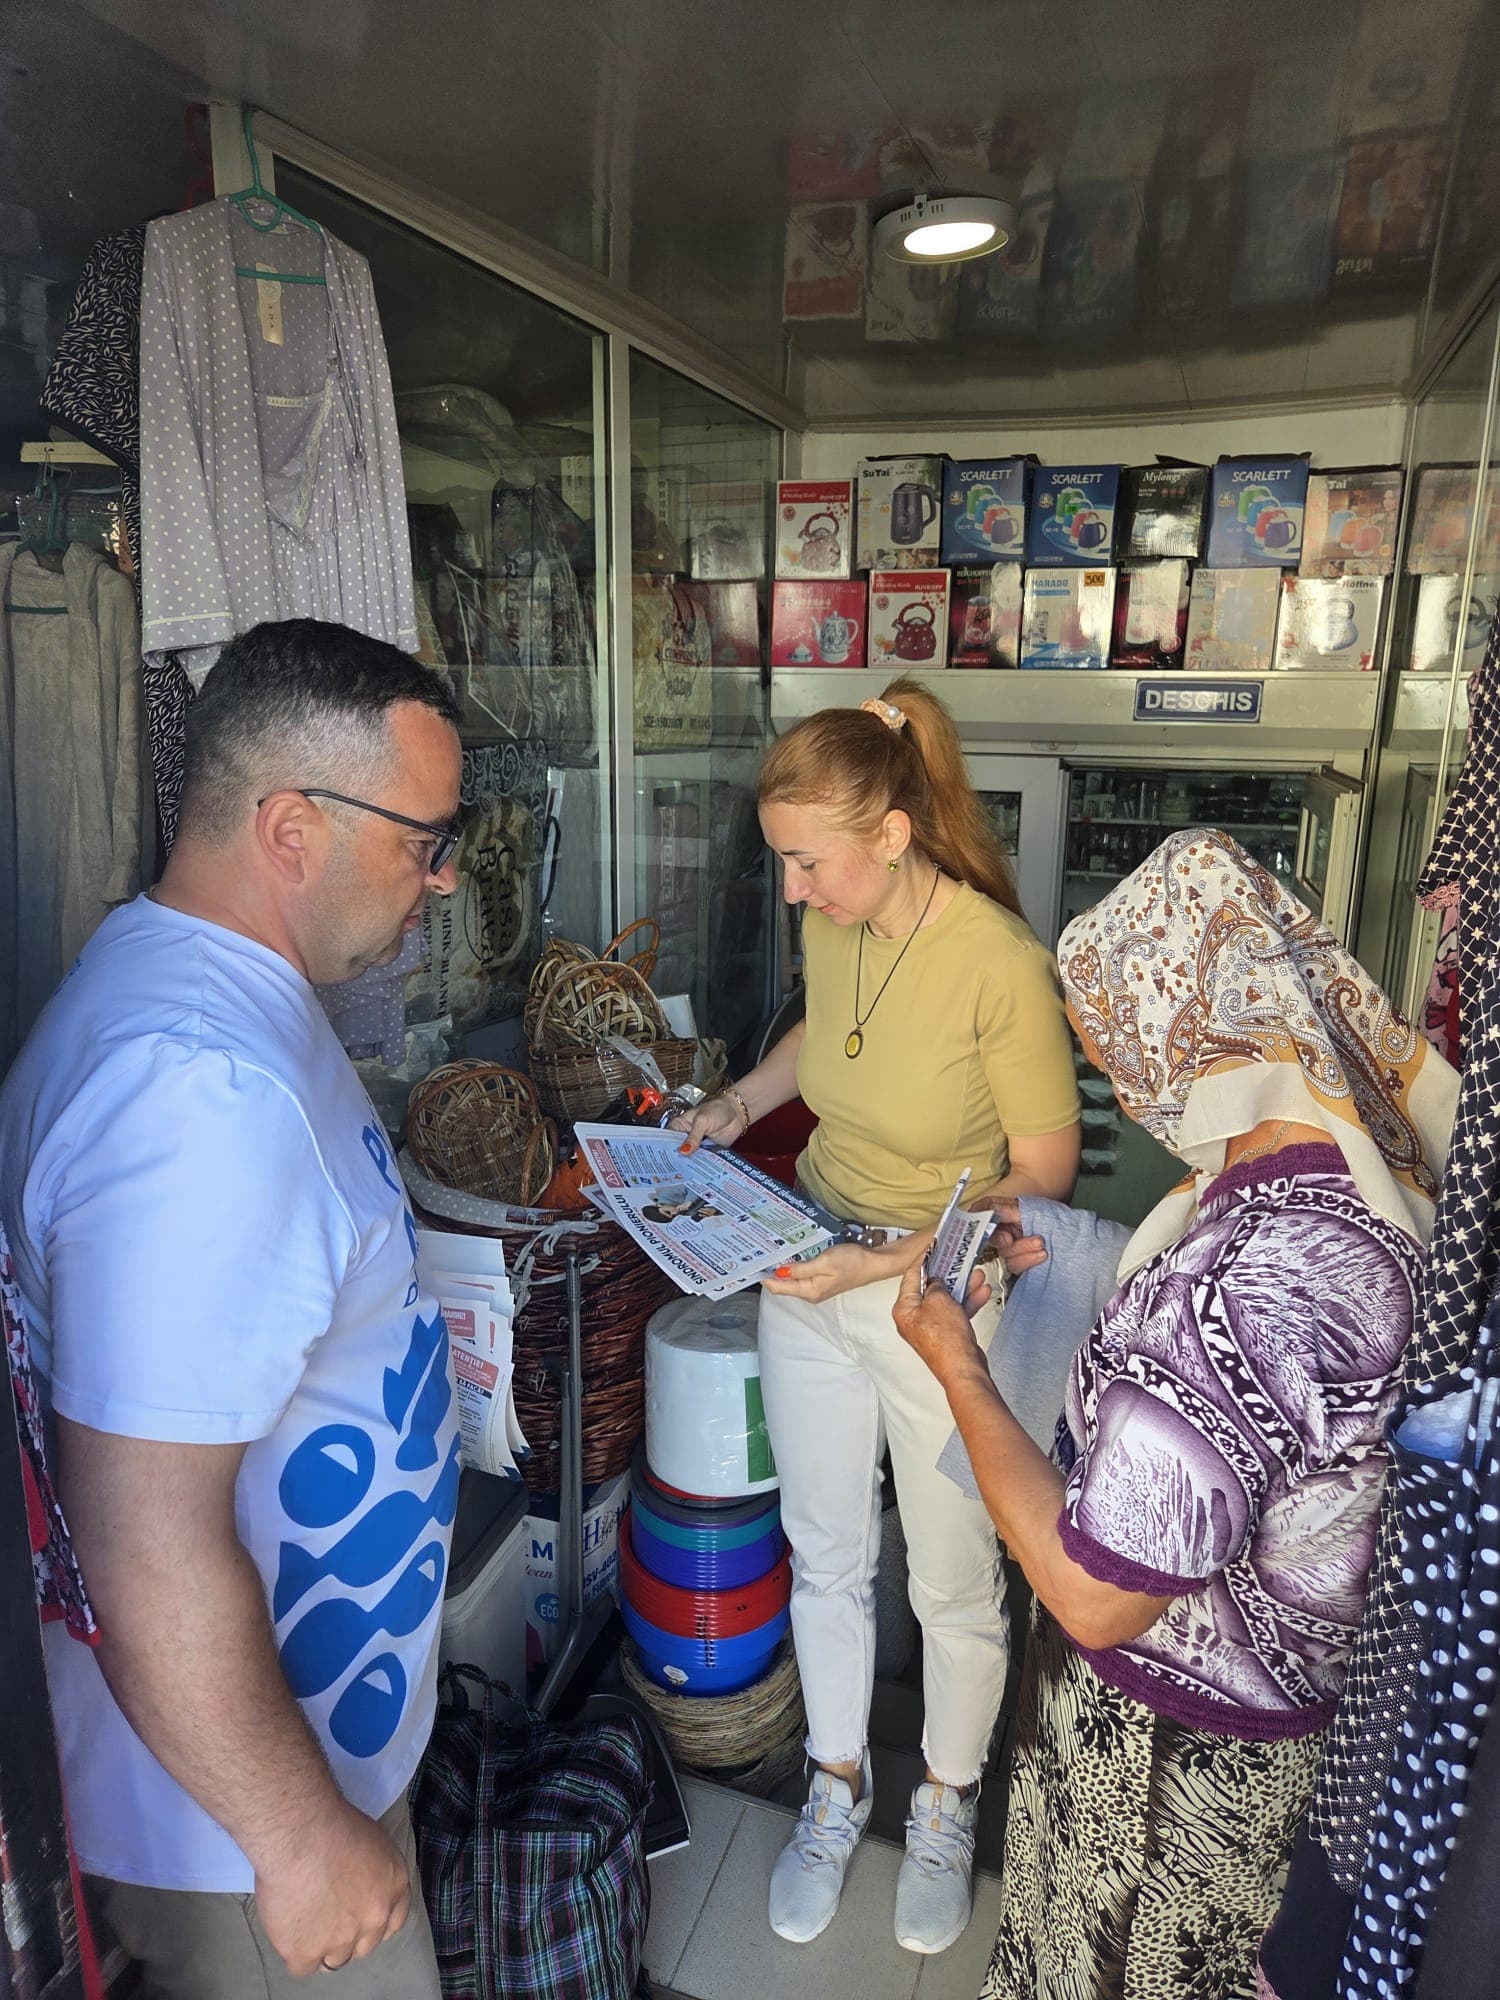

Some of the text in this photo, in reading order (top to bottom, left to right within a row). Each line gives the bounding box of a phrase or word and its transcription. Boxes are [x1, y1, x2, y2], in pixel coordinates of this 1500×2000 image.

[863, 465, 890, 478] SuTai
[960, 469, 1013, 482] SCARLETT
[1052, 473, 1104, 485] SCARLETT
[1232, 470, 1291, 482] SCARLETT
[1145, 690, 1252, 712] DESCHIS
[477, 847, 497, 968] Brava
[440, 909, 451, 950] MINK
[614, 1194, 660, 1245] PIONIERULUI
[655, 1245, 707, 1285] SINDROMUL
